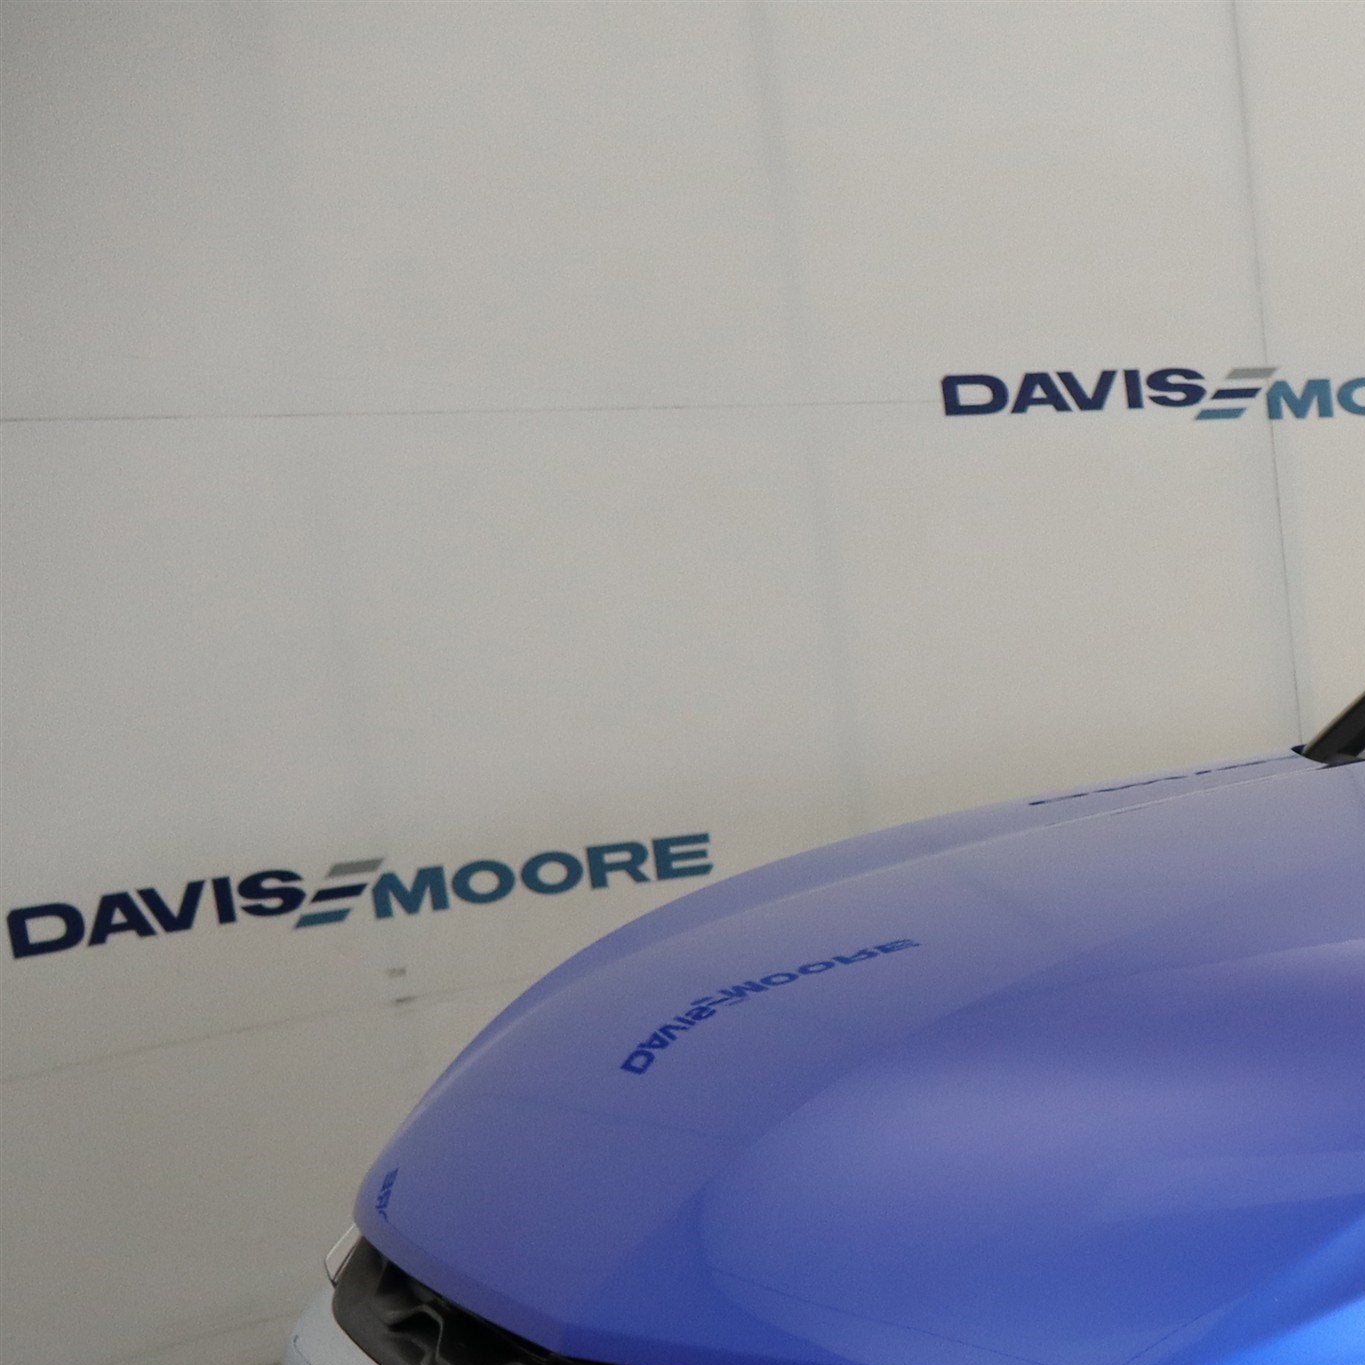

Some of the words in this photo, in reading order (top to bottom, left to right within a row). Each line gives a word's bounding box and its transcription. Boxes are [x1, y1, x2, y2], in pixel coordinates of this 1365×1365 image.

[941, 367, 1206, 417] DAVIS
[6, 866, 307, 960] DAVIS
[371, 832, 716, 921] MOORE
